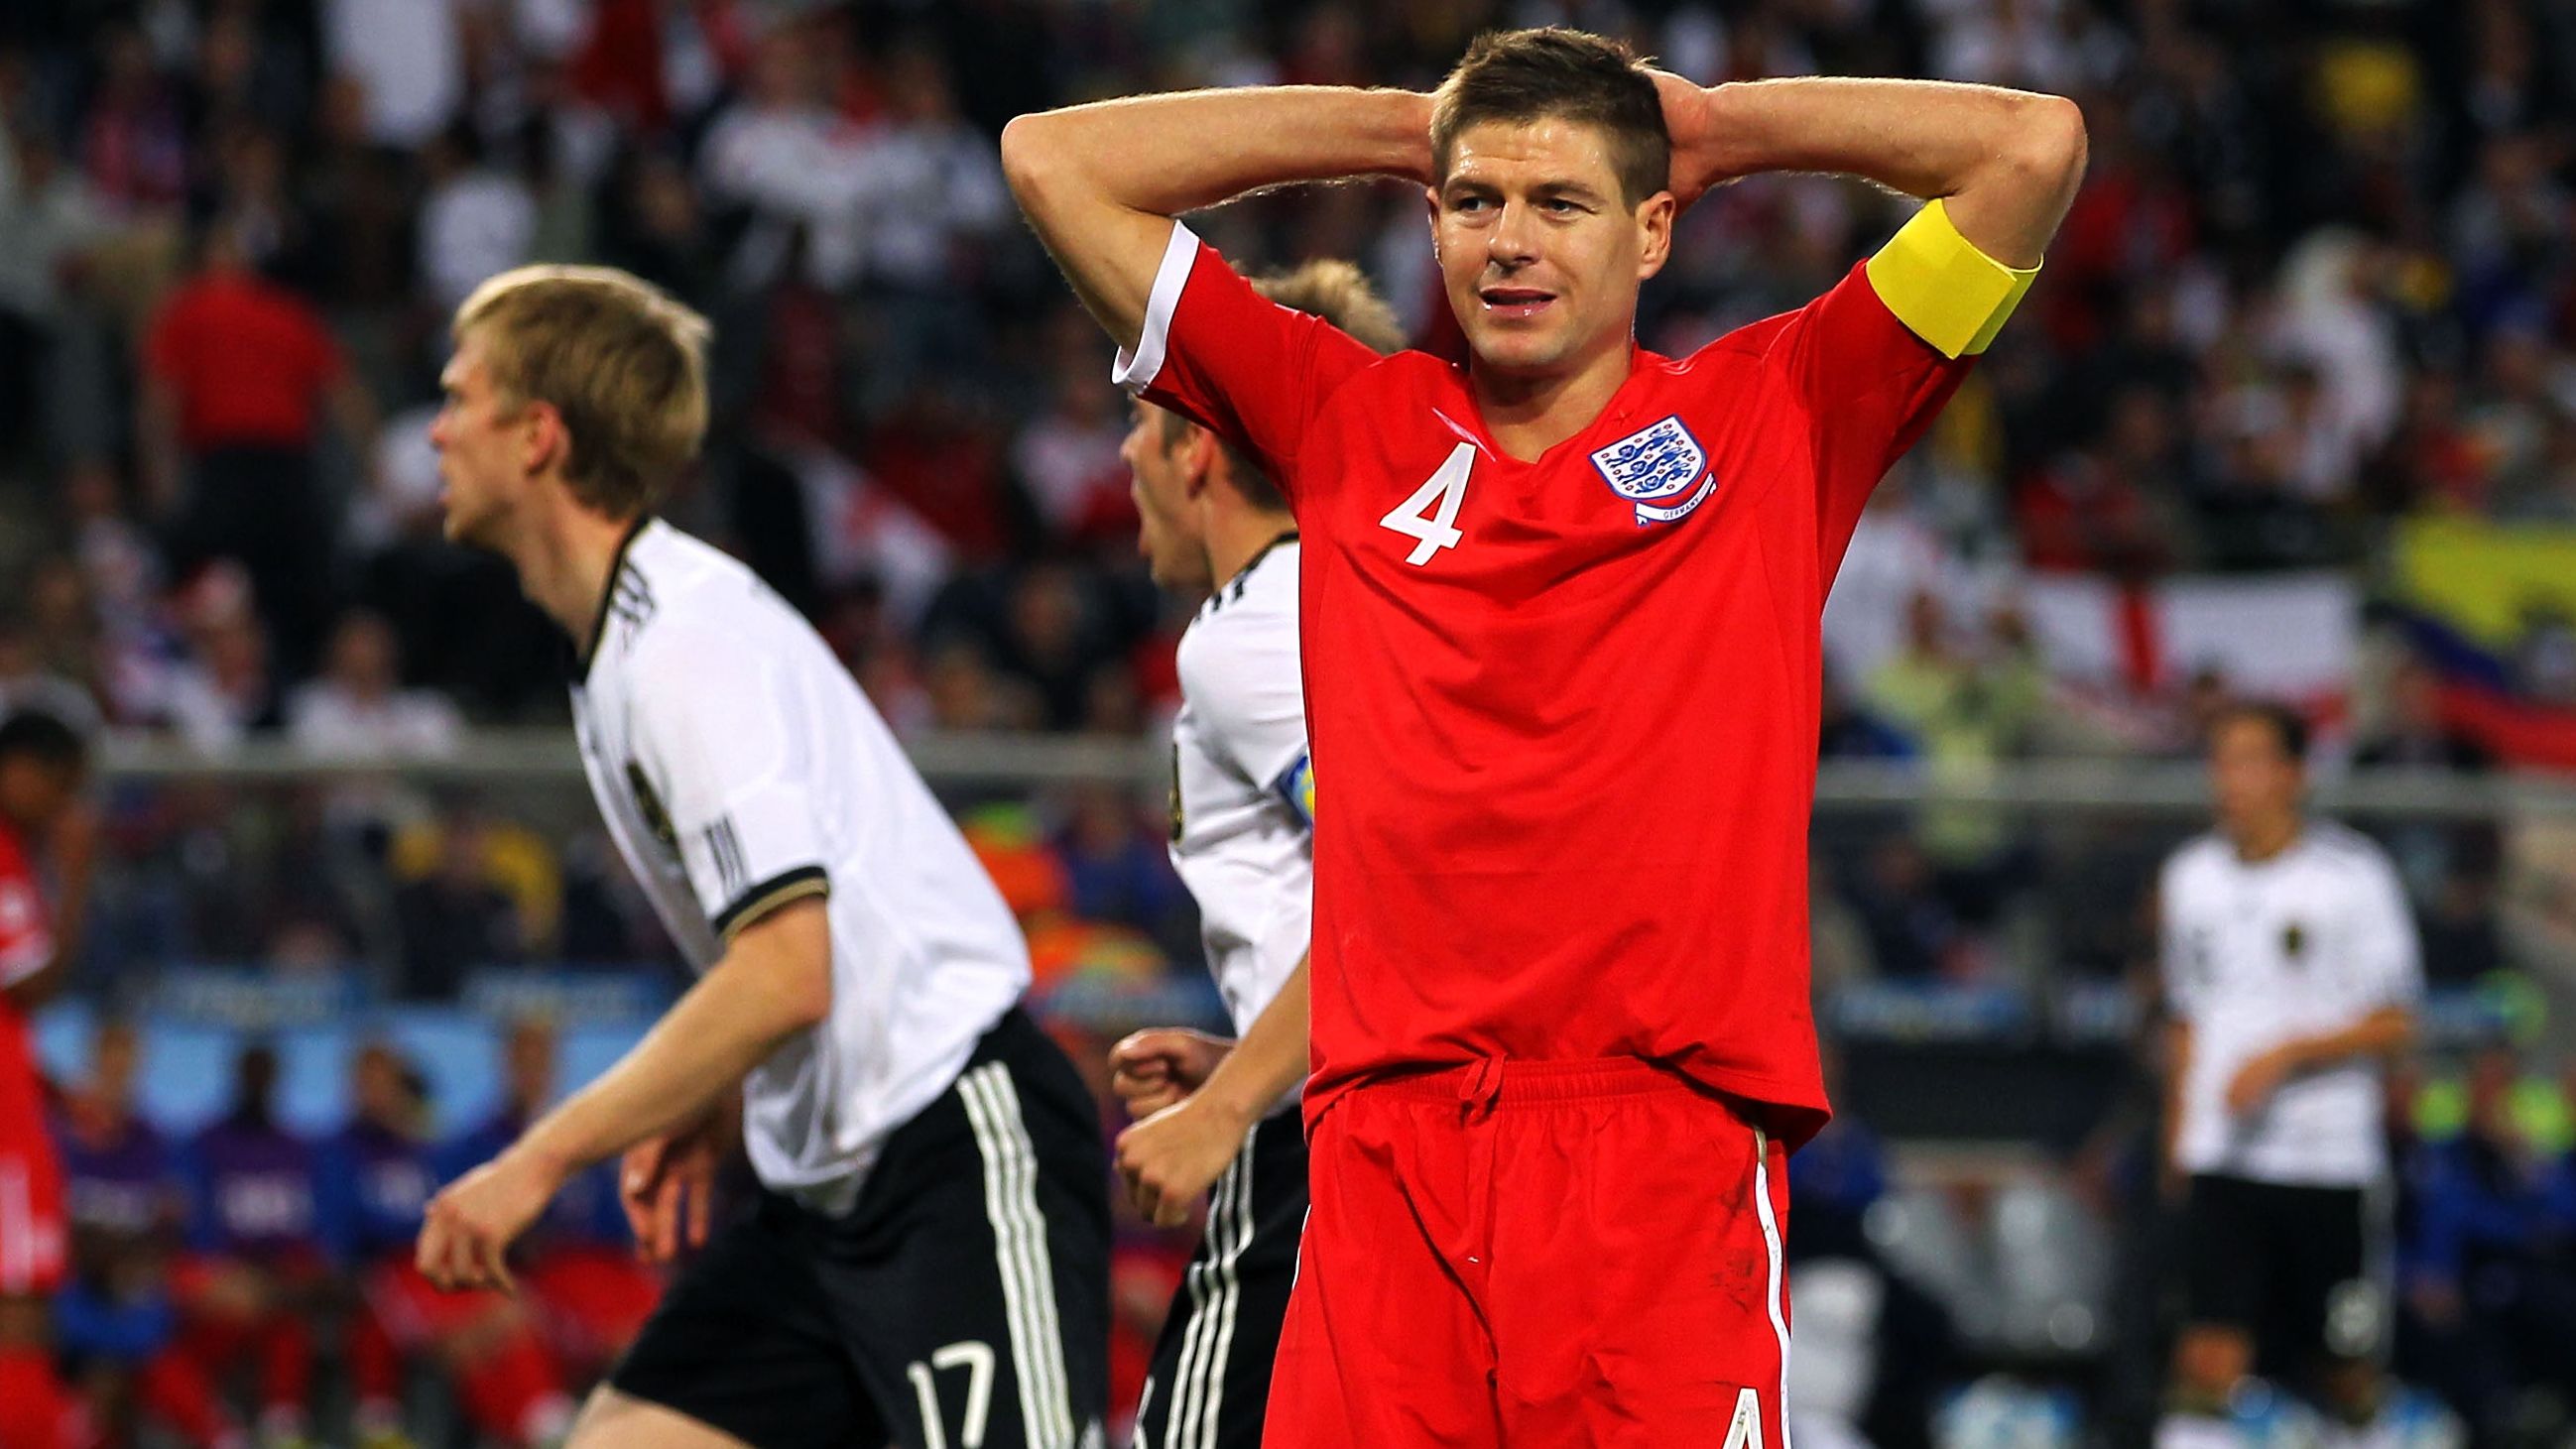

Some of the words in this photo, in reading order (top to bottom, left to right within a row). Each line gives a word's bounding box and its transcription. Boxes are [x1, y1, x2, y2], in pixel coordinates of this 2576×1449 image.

[1380, 442, 1476, 566] 4
[1663, 497, 1699, 519] GERMANY
[907, 1341, 996, 1449] 17
